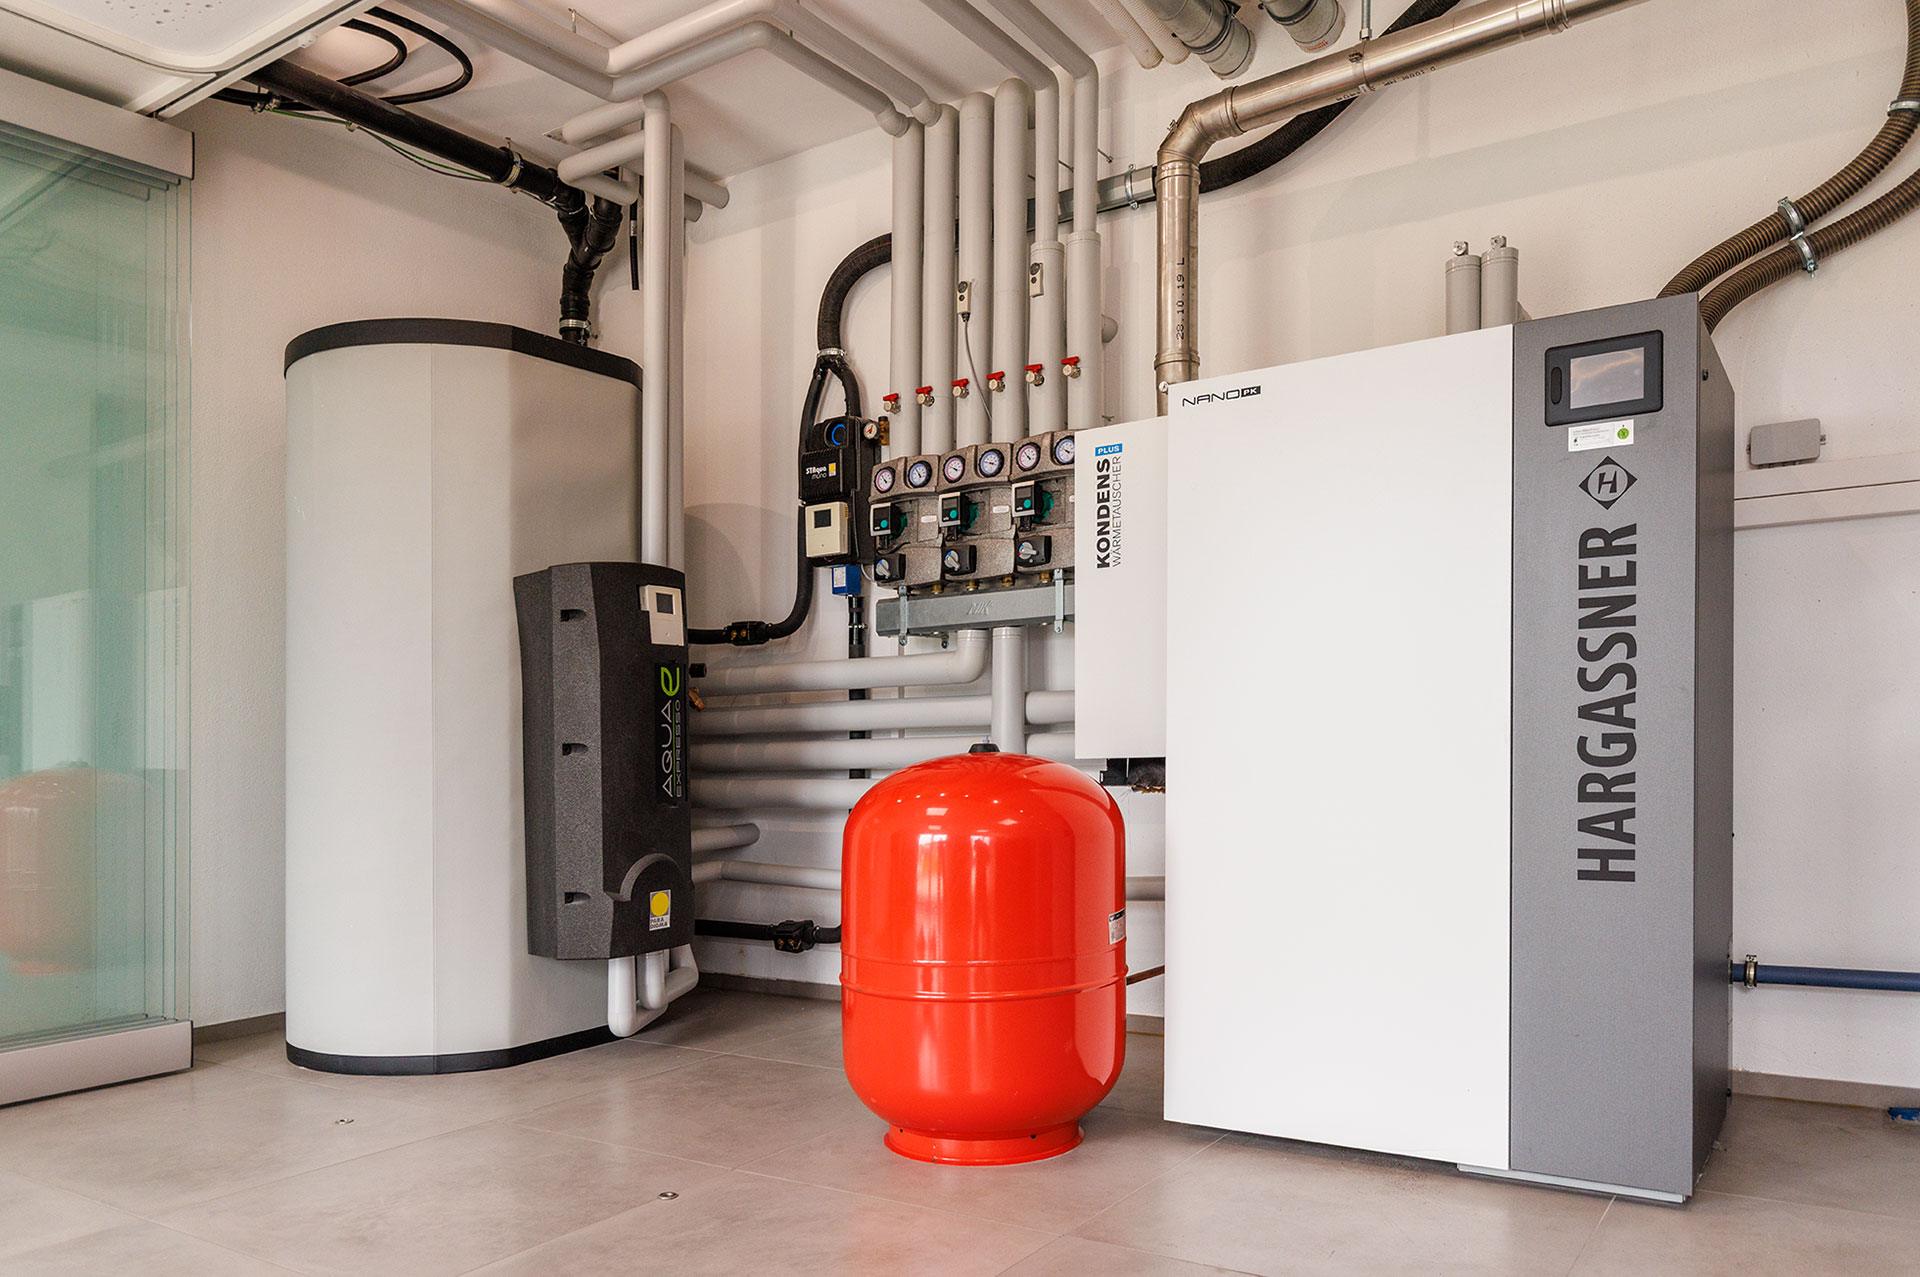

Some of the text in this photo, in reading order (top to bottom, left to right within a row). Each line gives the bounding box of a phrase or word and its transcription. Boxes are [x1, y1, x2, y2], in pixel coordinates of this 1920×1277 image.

[1097, 445, 1120, 455] PLUS
[1096, 458, 1111, 569] KONDENS
[1110, 456, 1122, 568] WÄRMETAUSCHER
[661, 700, 673, 798] AQUA
[674, 699, 682, 798] EXPRESSO
[1577, 523, 1637, 882] HARGASSNER
